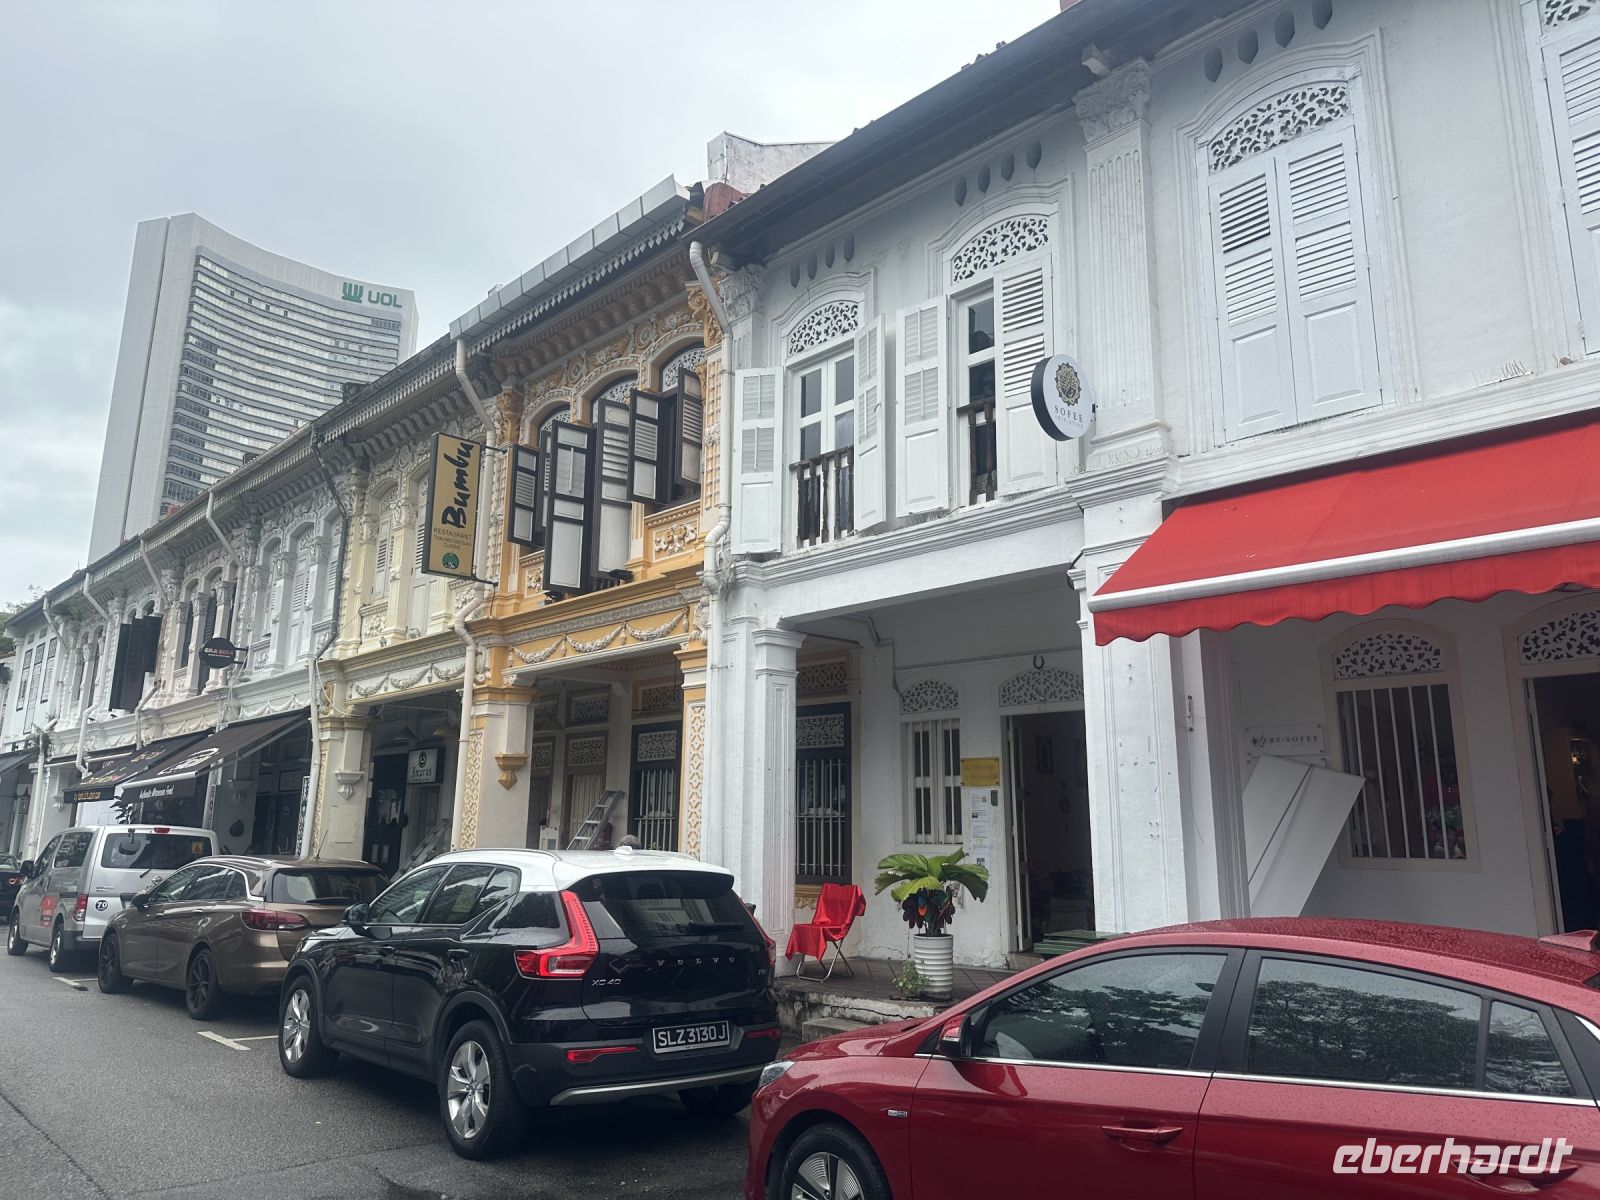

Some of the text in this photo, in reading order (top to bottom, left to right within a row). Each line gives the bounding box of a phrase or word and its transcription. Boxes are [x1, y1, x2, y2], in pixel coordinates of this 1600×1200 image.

[367, 290, 402, 308] UOL
[441, 442, 474, 528] Bumbu
[433, 528, 472, 540] RESTAURANT
[656, 957, 736, 967] VOLVO
[591, 978, 622, 987] XC40
